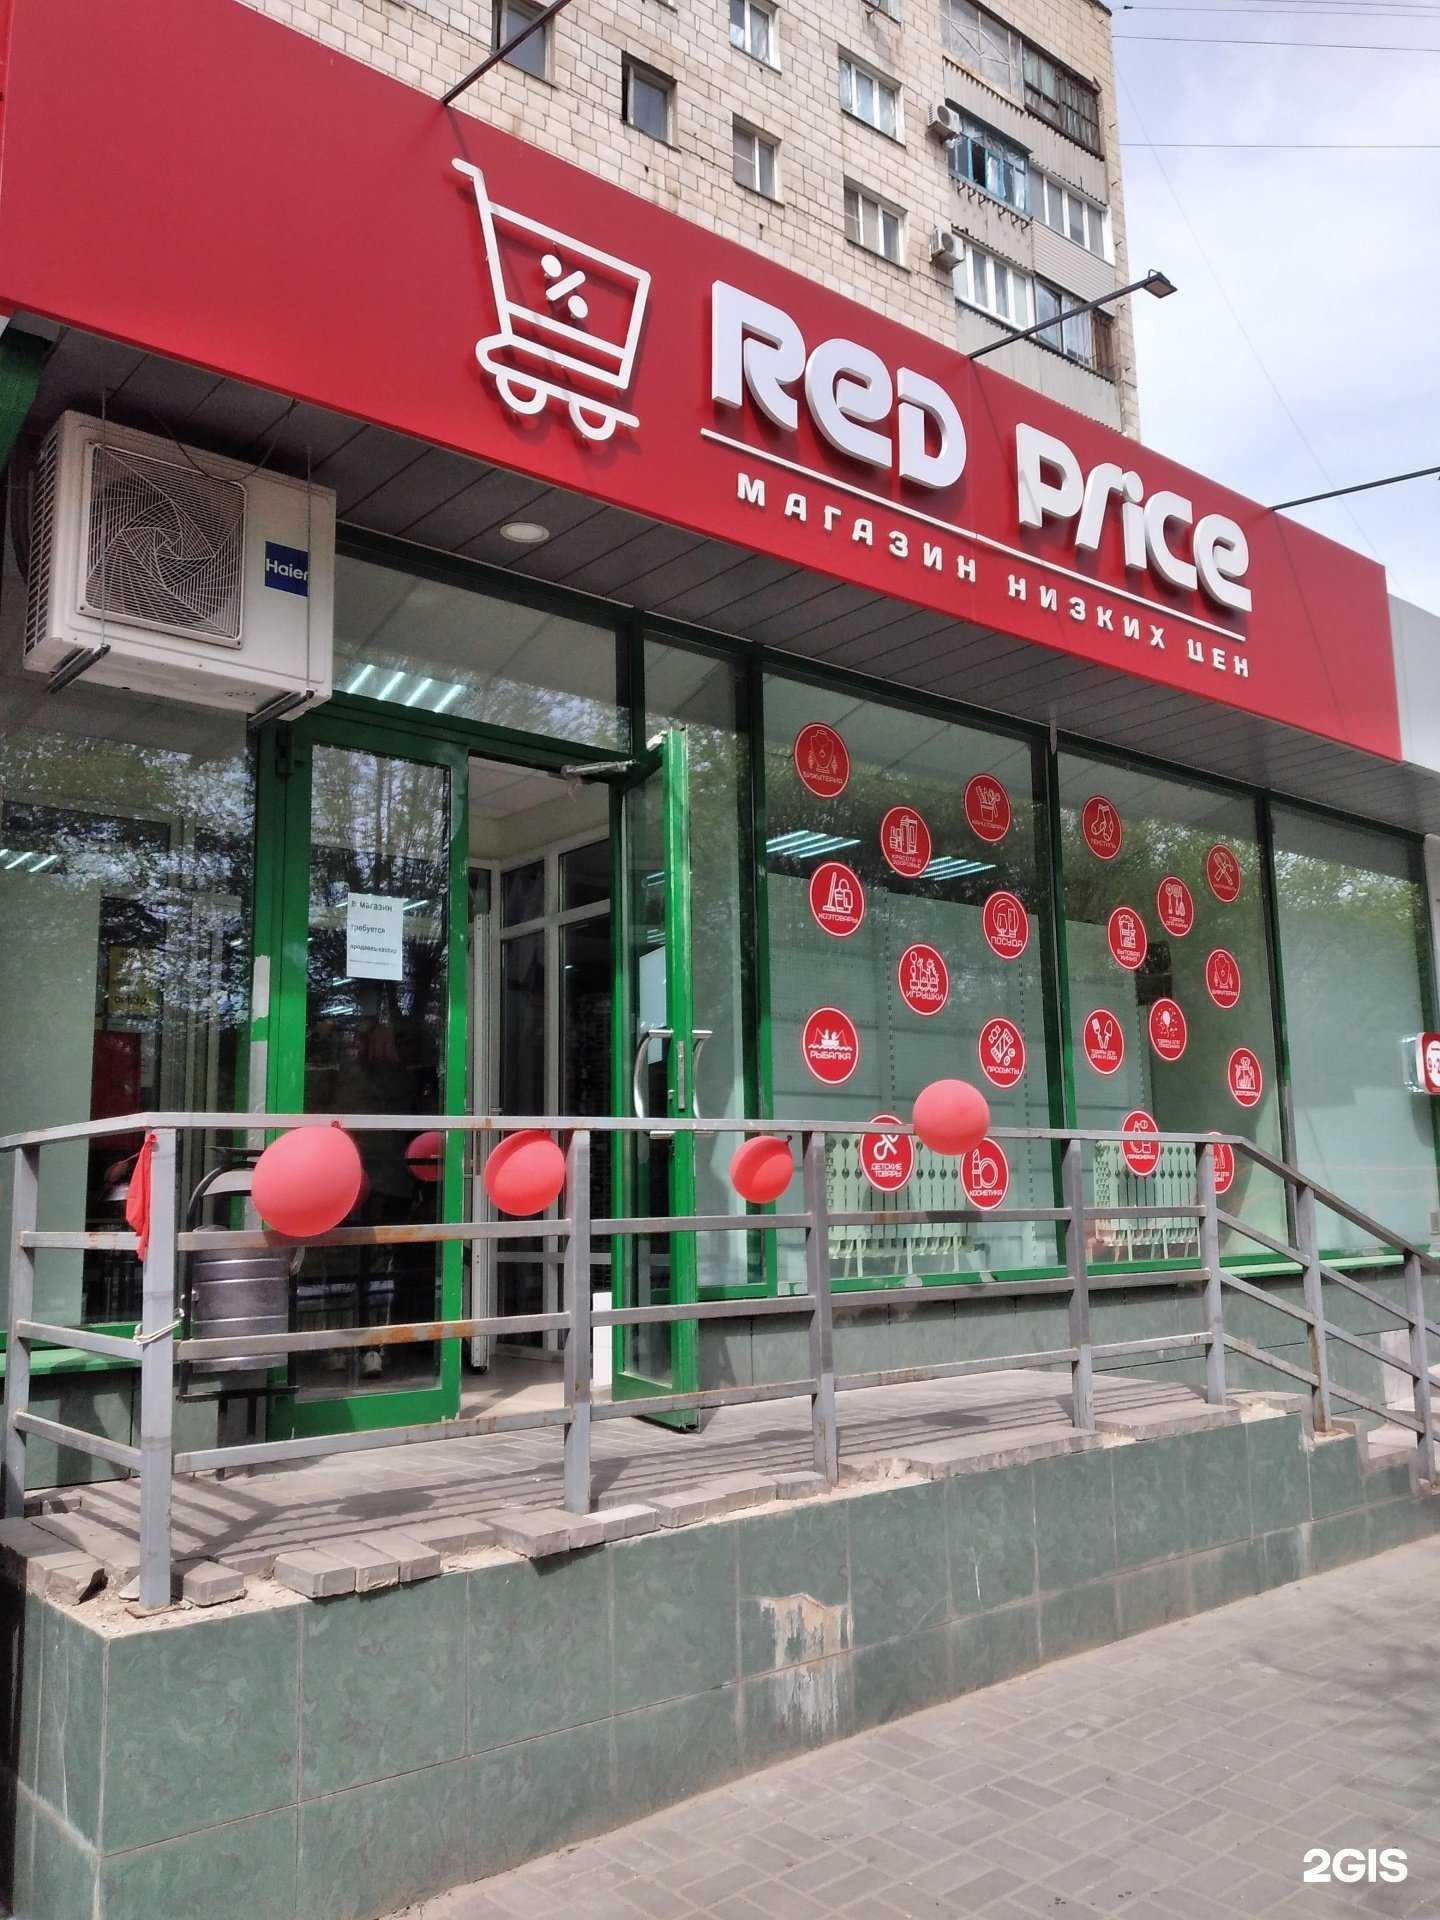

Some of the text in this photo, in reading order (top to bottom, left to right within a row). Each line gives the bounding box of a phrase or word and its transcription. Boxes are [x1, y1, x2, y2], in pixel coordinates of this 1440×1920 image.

[265, 558, 309, 580] Haier
[737, 472, 1249, 678] МАГАЗИН НИЗКИХ ЦЕН
[990, 935, 1024, 948] ПОСУДА
[906, 990, 944, 1001] ИГРУШКИ
[809, 1050, 852, 1061] РЫБАЛКА
[986, 1065, 1020, 1075] ПРОДУКТЫ
[872, 1163, 902, 1171] ДЕТСКИЕ
[875, 1170, 902, 1178] ТОВАРЫ
[969, 1189, 1003, 1197] КОСМЕТИКА
